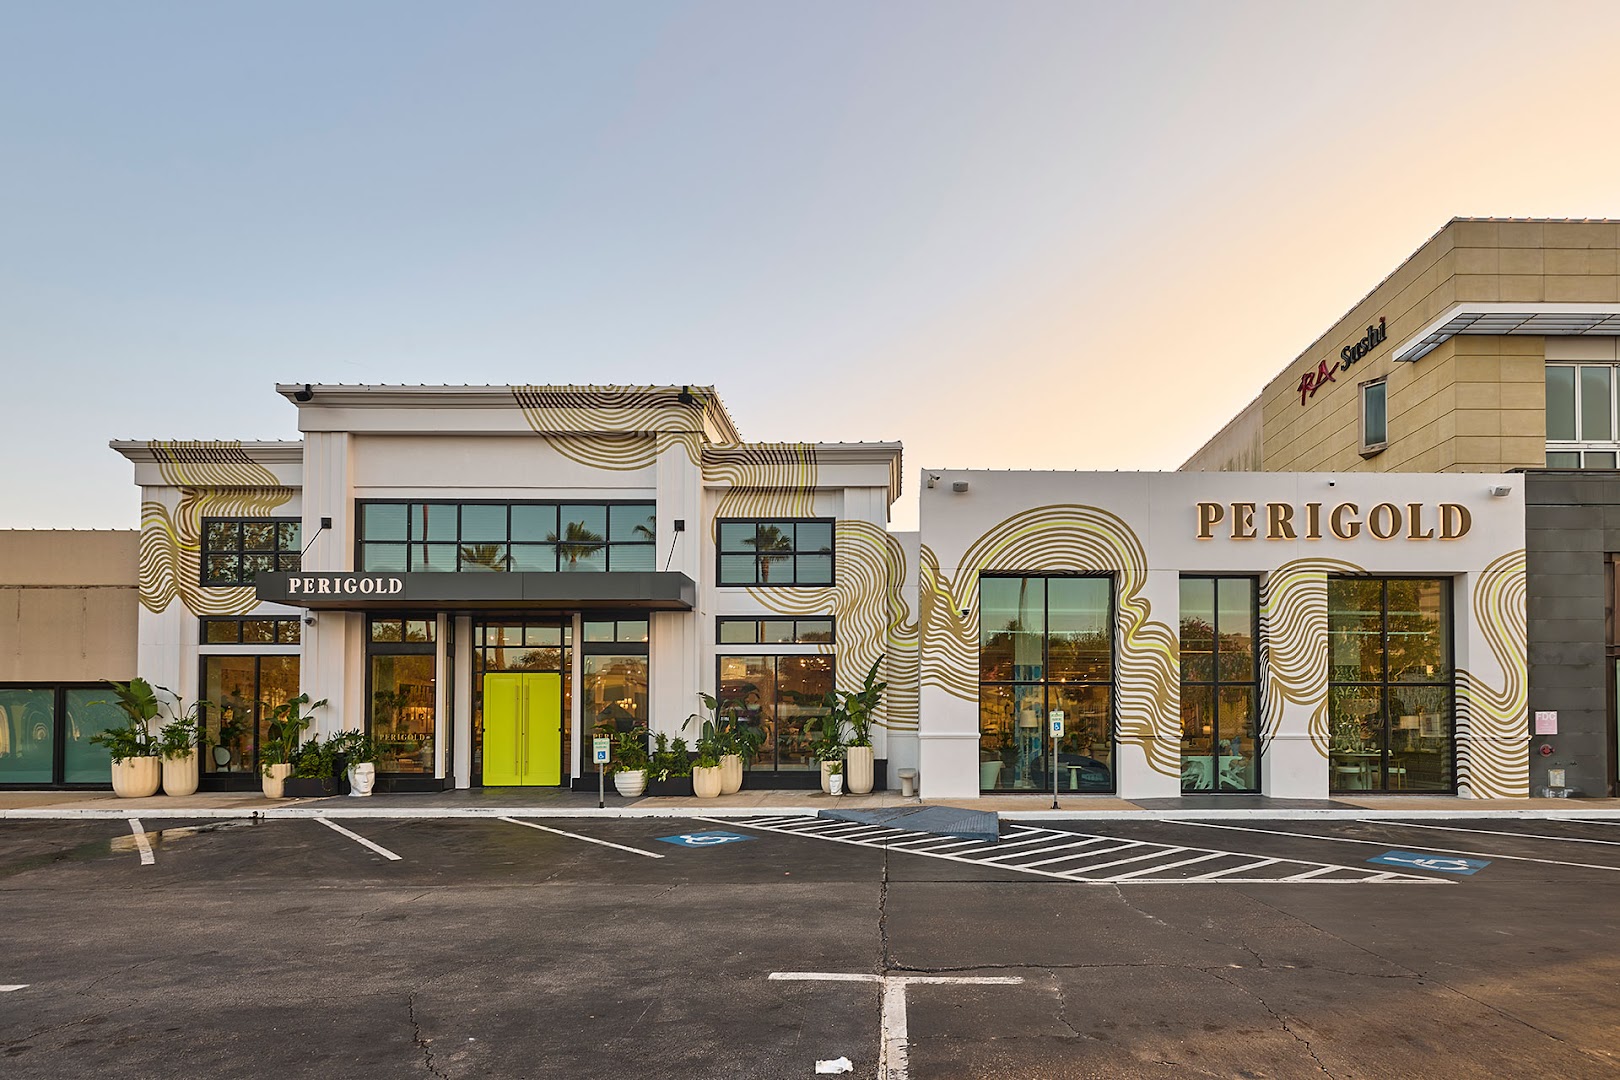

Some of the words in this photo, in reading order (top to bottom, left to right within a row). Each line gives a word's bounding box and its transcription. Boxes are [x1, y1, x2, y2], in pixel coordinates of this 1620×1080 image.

[1297, 360, 1340, 406] RA
[1341, 316, 1388, 372] Sushi
[1195, 502, 1472, 540] PERIGOLD
[288, 577, 403, 594] PERIGOLD
[1536, 713, 1556, 721] FDC
[379, 733, 426, 741] PERIGOLD
